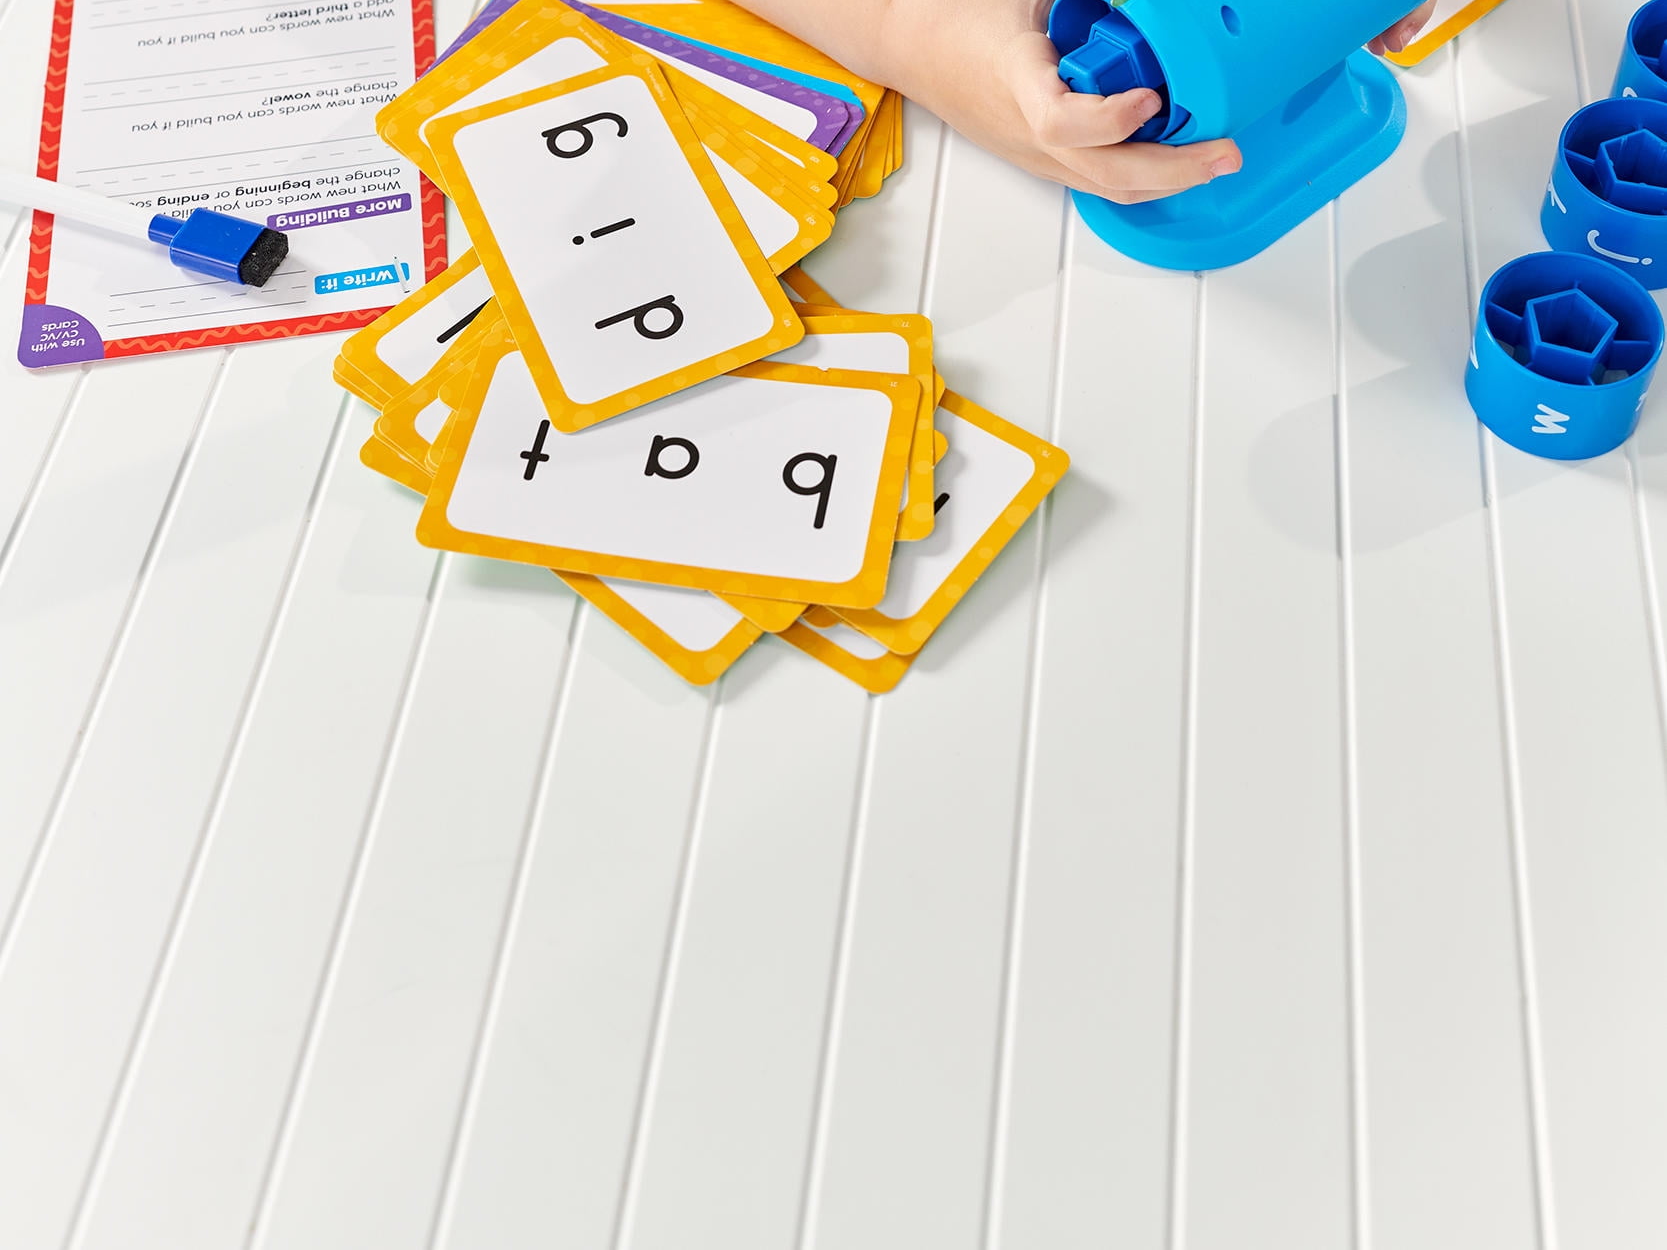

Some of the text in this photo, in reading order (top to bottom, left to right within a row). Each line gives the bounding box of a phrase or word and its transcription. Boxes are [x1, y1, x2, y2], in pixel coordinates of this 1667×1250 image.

[265, 8, 311, 22] letter?
[316, 3, 349, 15] third
[137, 8, 395, 48] What new words can you build if you
[261, 80, 398, 105] change the vowel?
[131, 93, 398, 133] What new words can you build if you
[316, 176, 340, 187] the
[344, 168, 401, 183] change
[235, 180, 311, 197] beginning
[326, 187, 356, 197] new
[361, 181, 401, 194] What
[157, 194, 209, 206] ending
[214, 190, 230, 199] or
[277, 192, 322, 205] words
[213, 200, 241, 212] you
[245, 199, 273, 209] can
[275, 198, 402, 229] More Building
[320, 270, 393, 290] Write it:
[41, 320, 79, 331] Cards
[40, 330, 79, 341] CV/VC
[31, 338, 85, 352] Use with
